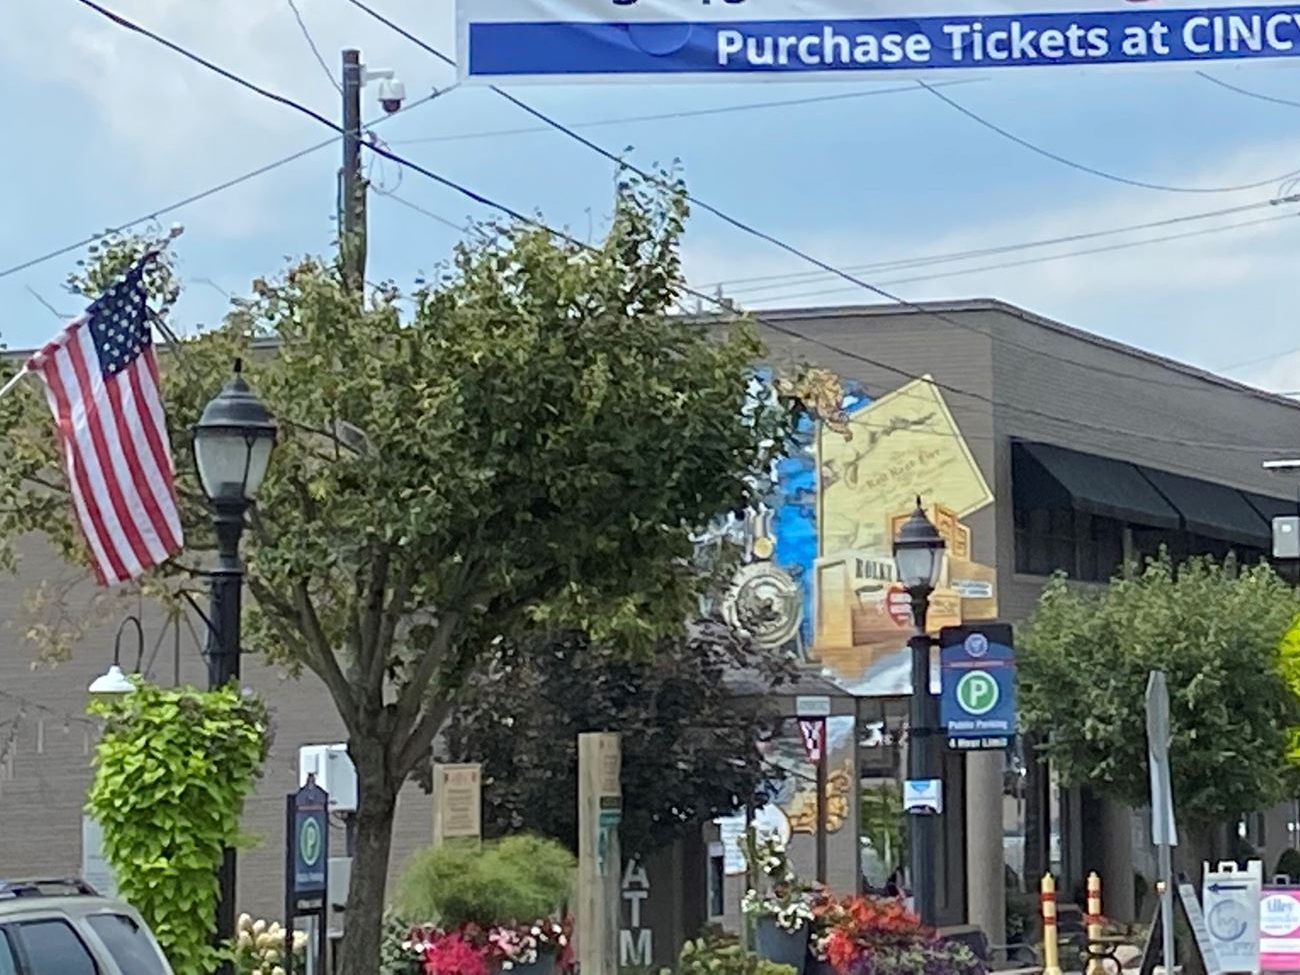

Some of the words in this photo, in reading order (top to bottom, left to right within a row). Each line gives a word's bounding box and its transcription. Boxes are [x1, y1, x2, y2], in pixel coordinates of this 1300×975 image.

[717, 25, 931, 66] Purchase
[943, 19, 1109, 63] Tickets
[1122, 22, 1169, 57] at
[969, 679, 989, 707] P
[620, 857, 653, 967] ATM
